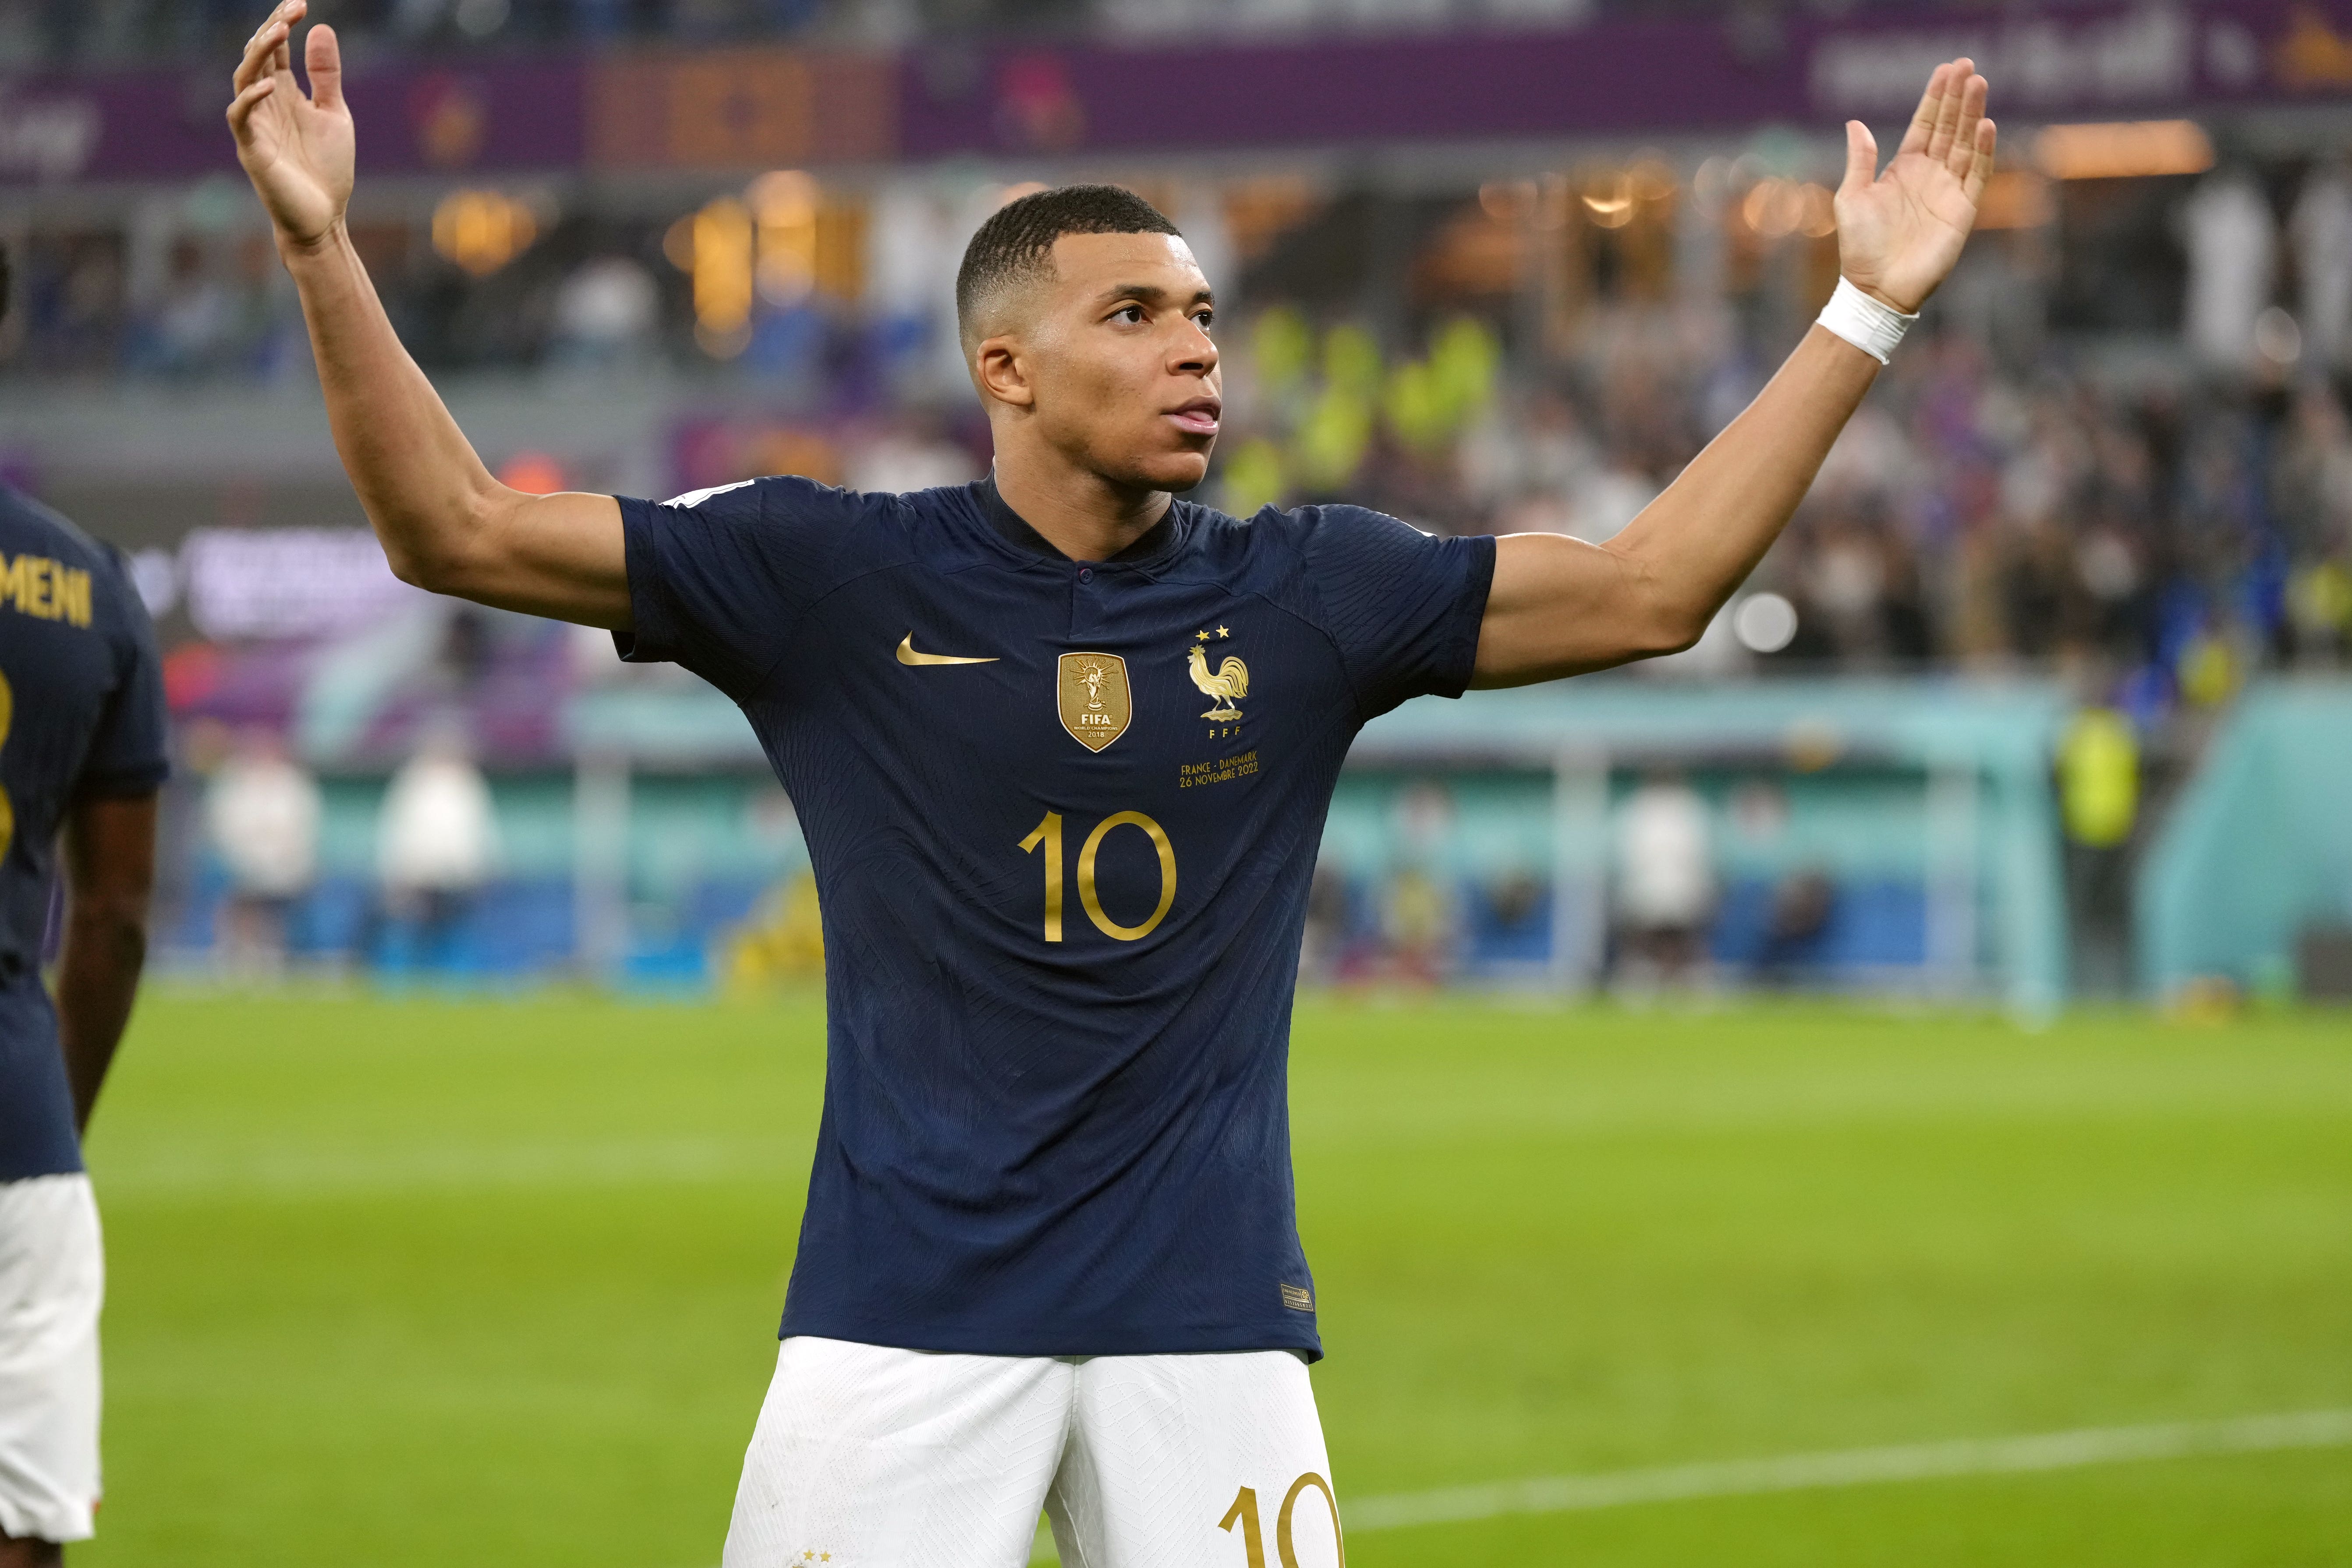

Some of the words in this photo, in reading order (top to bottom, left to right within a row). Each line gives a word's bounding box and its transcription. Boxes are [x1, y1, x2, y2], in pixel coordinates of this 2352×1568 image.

[1081, 714, 1111, 725] FIFA
[1180, 776, 1192, 788] 26
[1195, 768, 1236, 786] NOVEMBRE
[1238, 761, 1259, 776] 2022
[1181, 762, 1210, 775] FRANCE
[1219, 750, 1257, 770] DANEMARK
[1017, 810, 1177, 942] 10
[1282, 1288, 1300, 1296] ENGINEERED
[1218, 1472, 1345, 1568] 10
